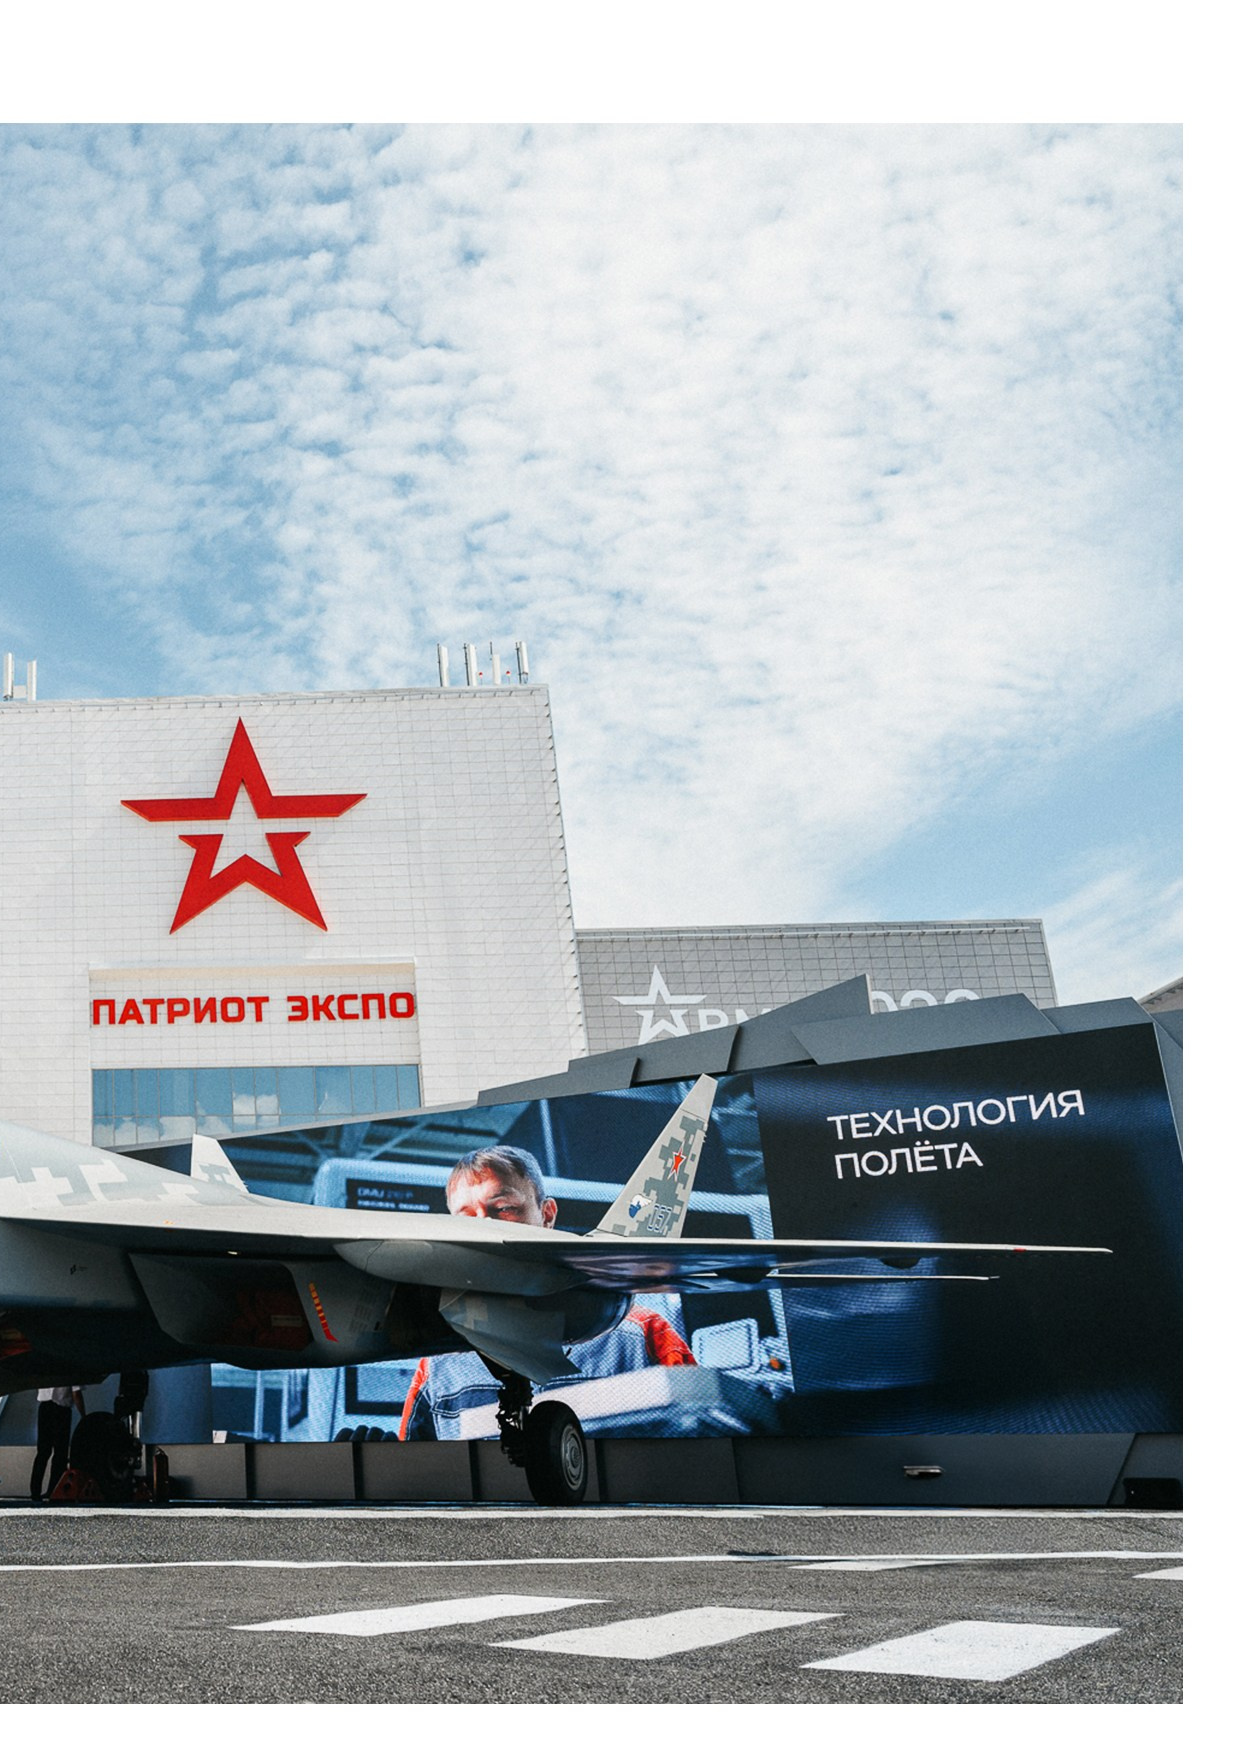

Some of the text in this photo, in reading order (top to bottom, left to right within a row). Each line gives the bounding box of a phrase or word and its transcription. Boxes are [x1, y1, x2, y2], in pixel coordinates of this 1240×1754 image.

[92, 992, 416, 1025] ПАТРИОТ ЭКСПО
[827, 1089, 1086, 1140] ТЕХНОЛОГИЯ
[834, 1140, 984, 1180] ПОЛЁТА
[646, 1203, 673, 1233] 057
